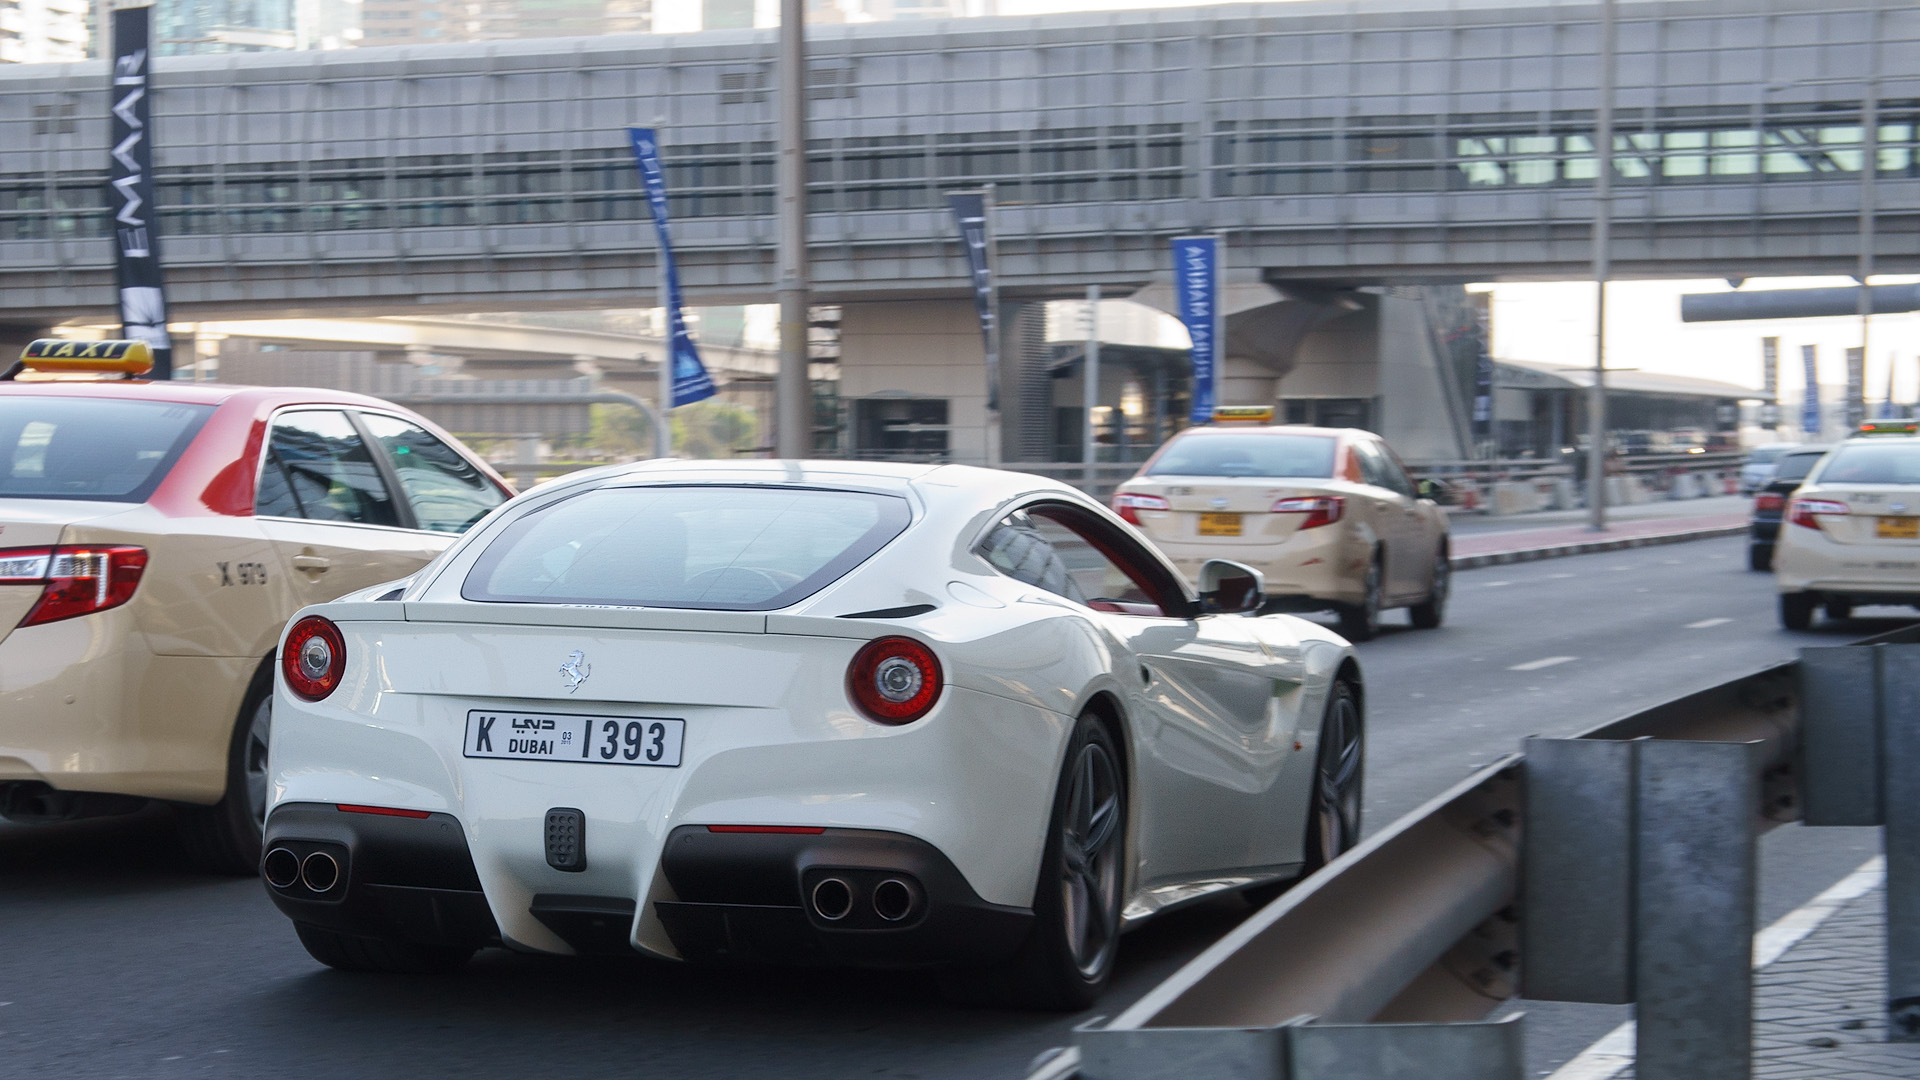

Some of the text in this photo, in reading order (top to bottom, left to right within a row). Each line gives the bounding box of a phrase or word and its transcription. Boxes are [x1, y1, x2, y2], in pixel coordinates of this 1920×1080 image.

[111, 49, 150, 258] EMAAR
[40, 341, 119, 357] TAXI
[216, 561, 268, 587] X 979
[476, 716, 496, 752] K
[511, 718, 556, 735] دبي
[562, 731, 572, 740] 03
[508, 738, 554, 755] DUBAI
[581, 719, 666, 762] 1393
